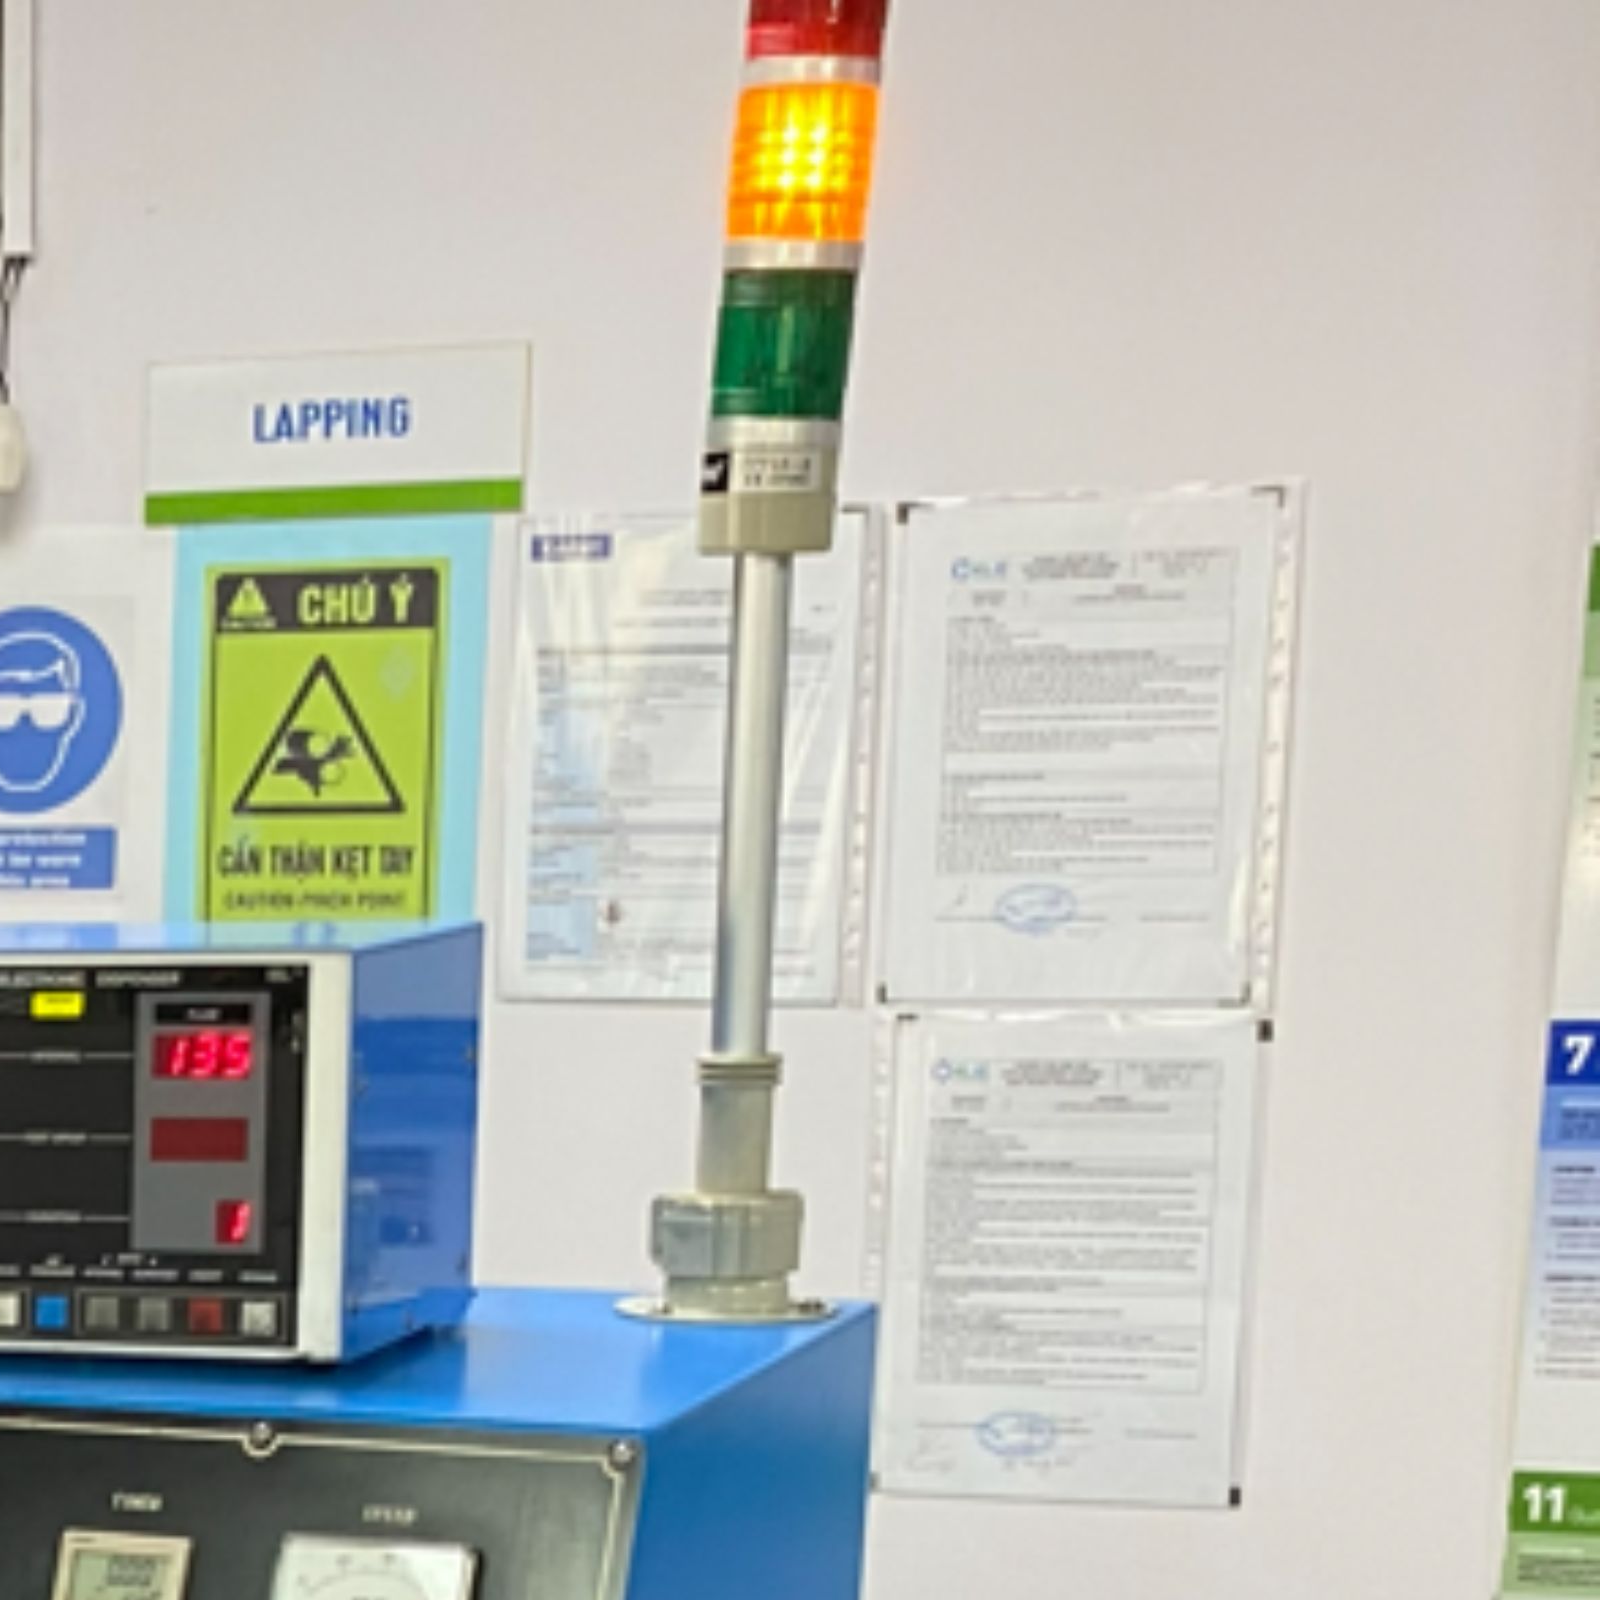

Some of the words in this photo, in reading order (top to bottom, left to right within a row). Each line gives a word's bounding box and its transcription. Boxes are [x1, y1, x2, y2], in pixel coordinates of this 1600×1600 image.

[252, 394, 411, 443] LAPPING
[295, 573, 377, 625] CHÚ
[170, 1030, 253, 1080] 135
[1563, 1034, 1595, 1077] 7
[1522, 1483, 1567, 1524] 11
